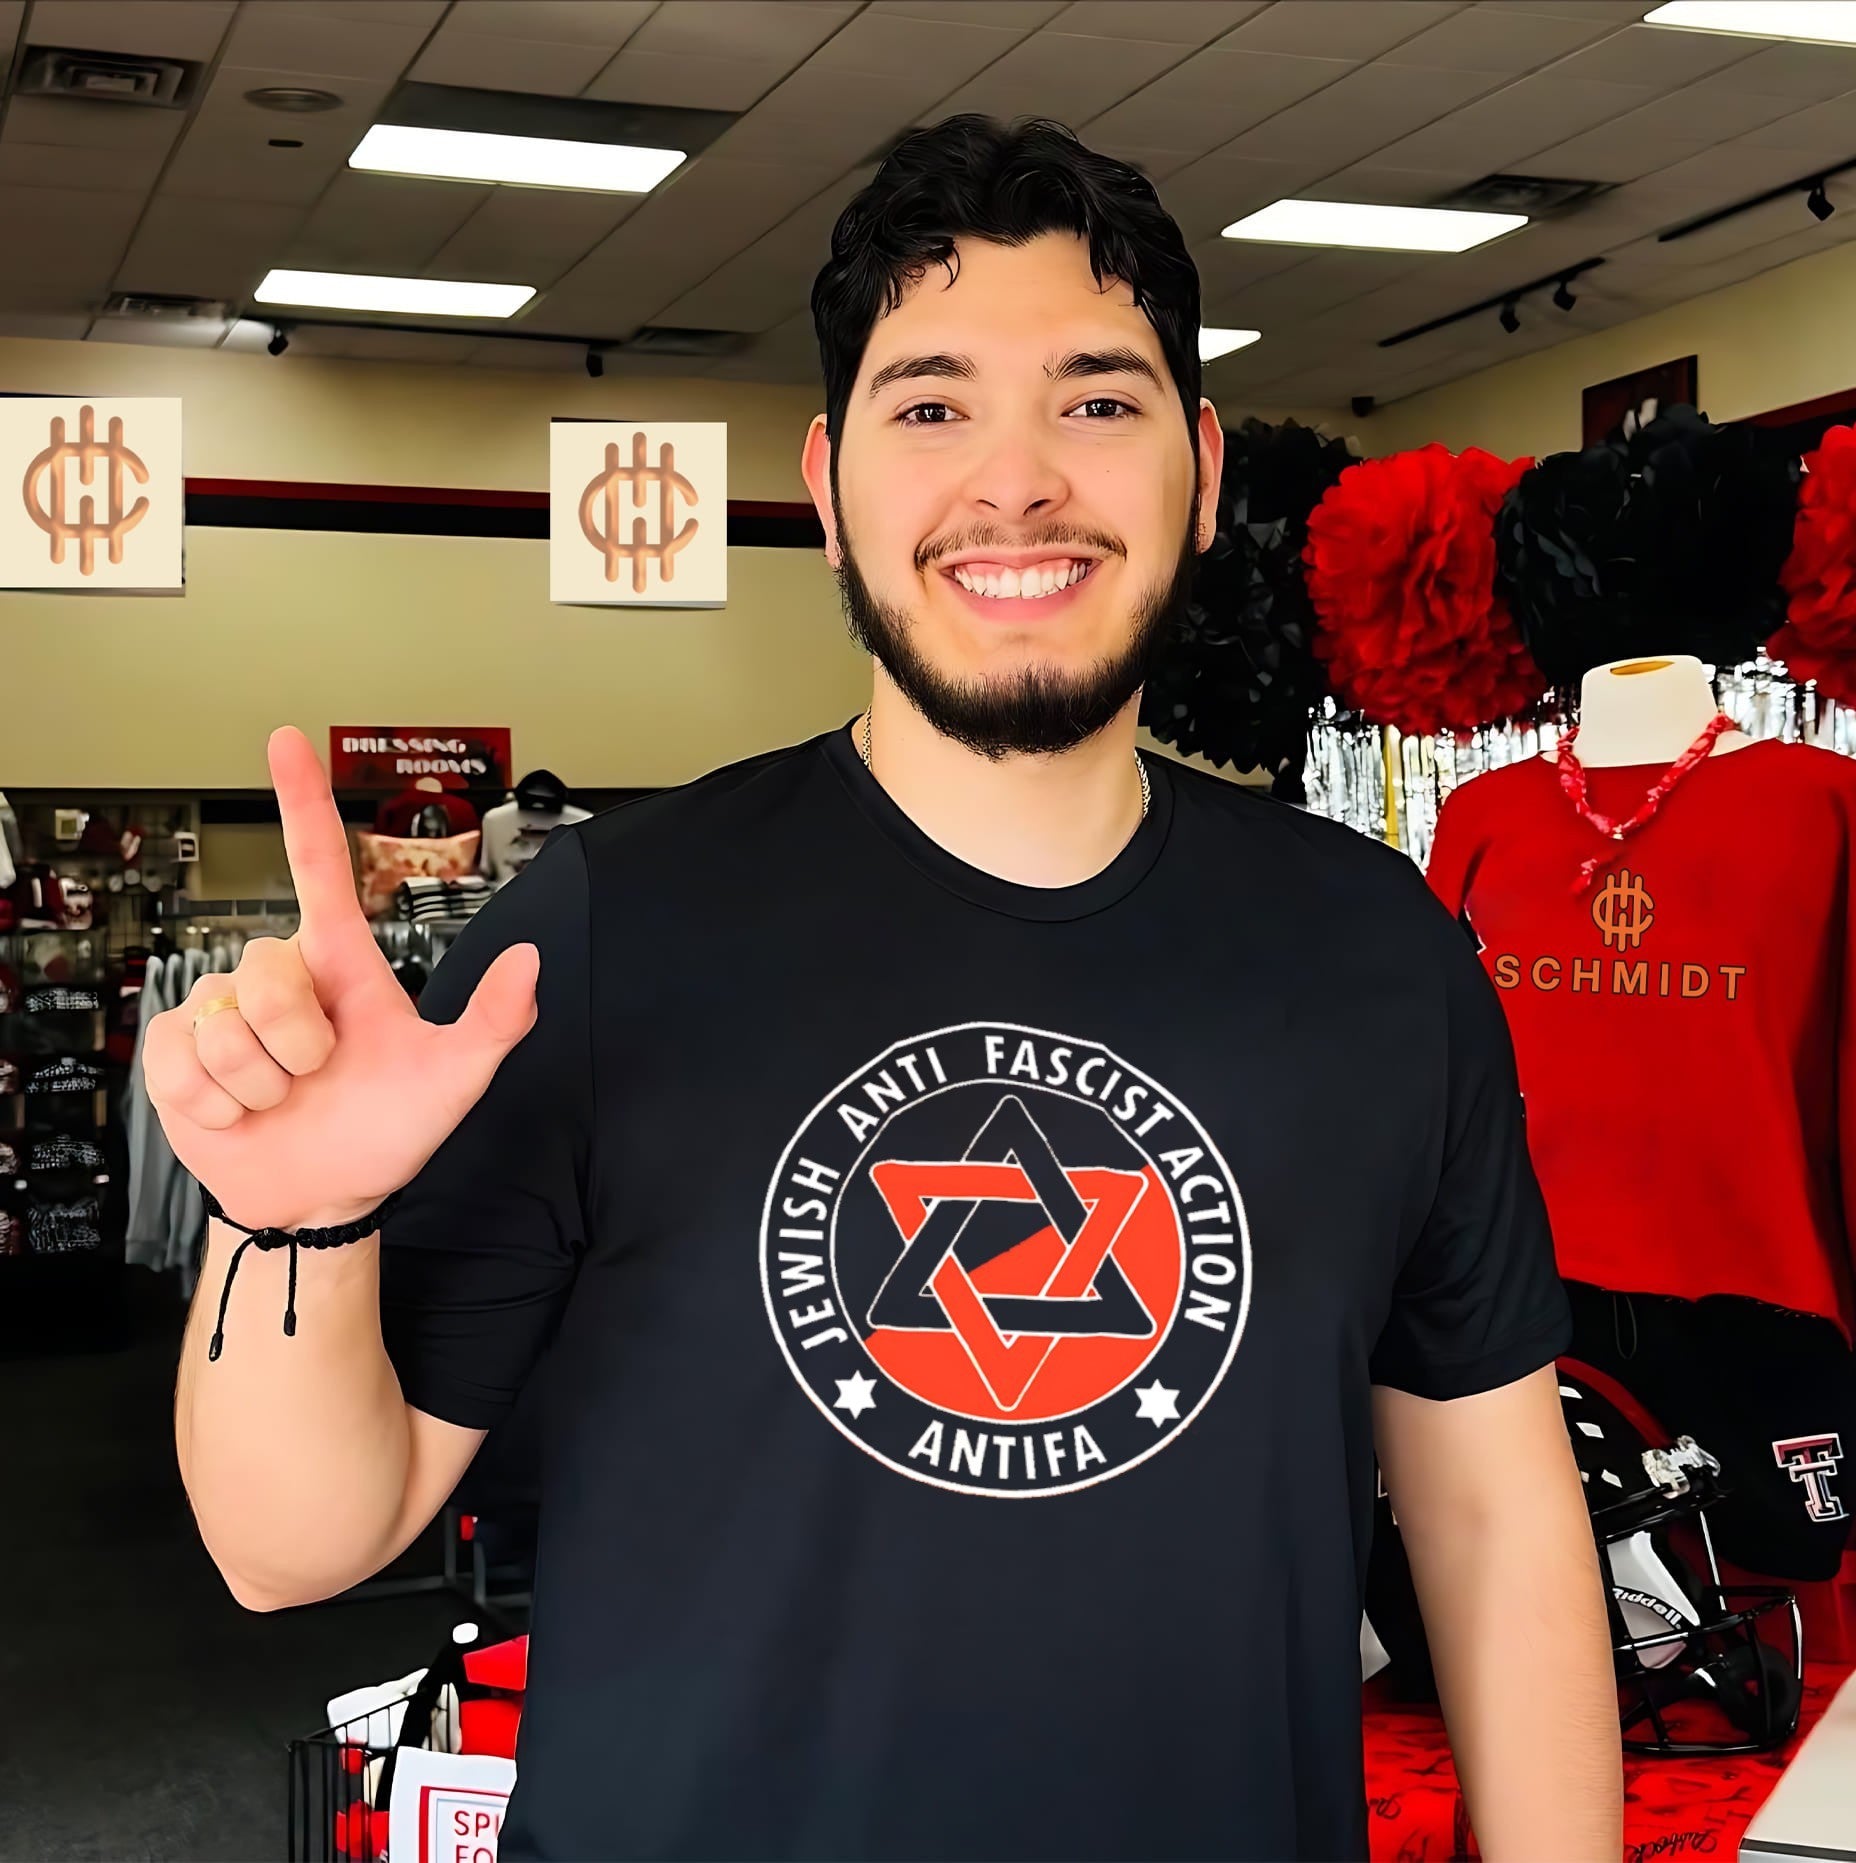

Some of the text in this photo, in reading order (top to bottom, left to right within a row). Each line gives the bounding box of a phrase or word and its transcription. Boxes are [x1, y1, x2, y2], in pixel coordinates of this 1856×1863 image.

[342, 737, 467, 753] DRESSING
[396, 758, 487, 774] ROOMS
[1494, 955, 1746, 999] SCHMIDT
[777, 1035, 1237, 1350] JEWISH ANTI FASCIST ACTION
[907, 1419, 1108, 1480] ANTIFA
